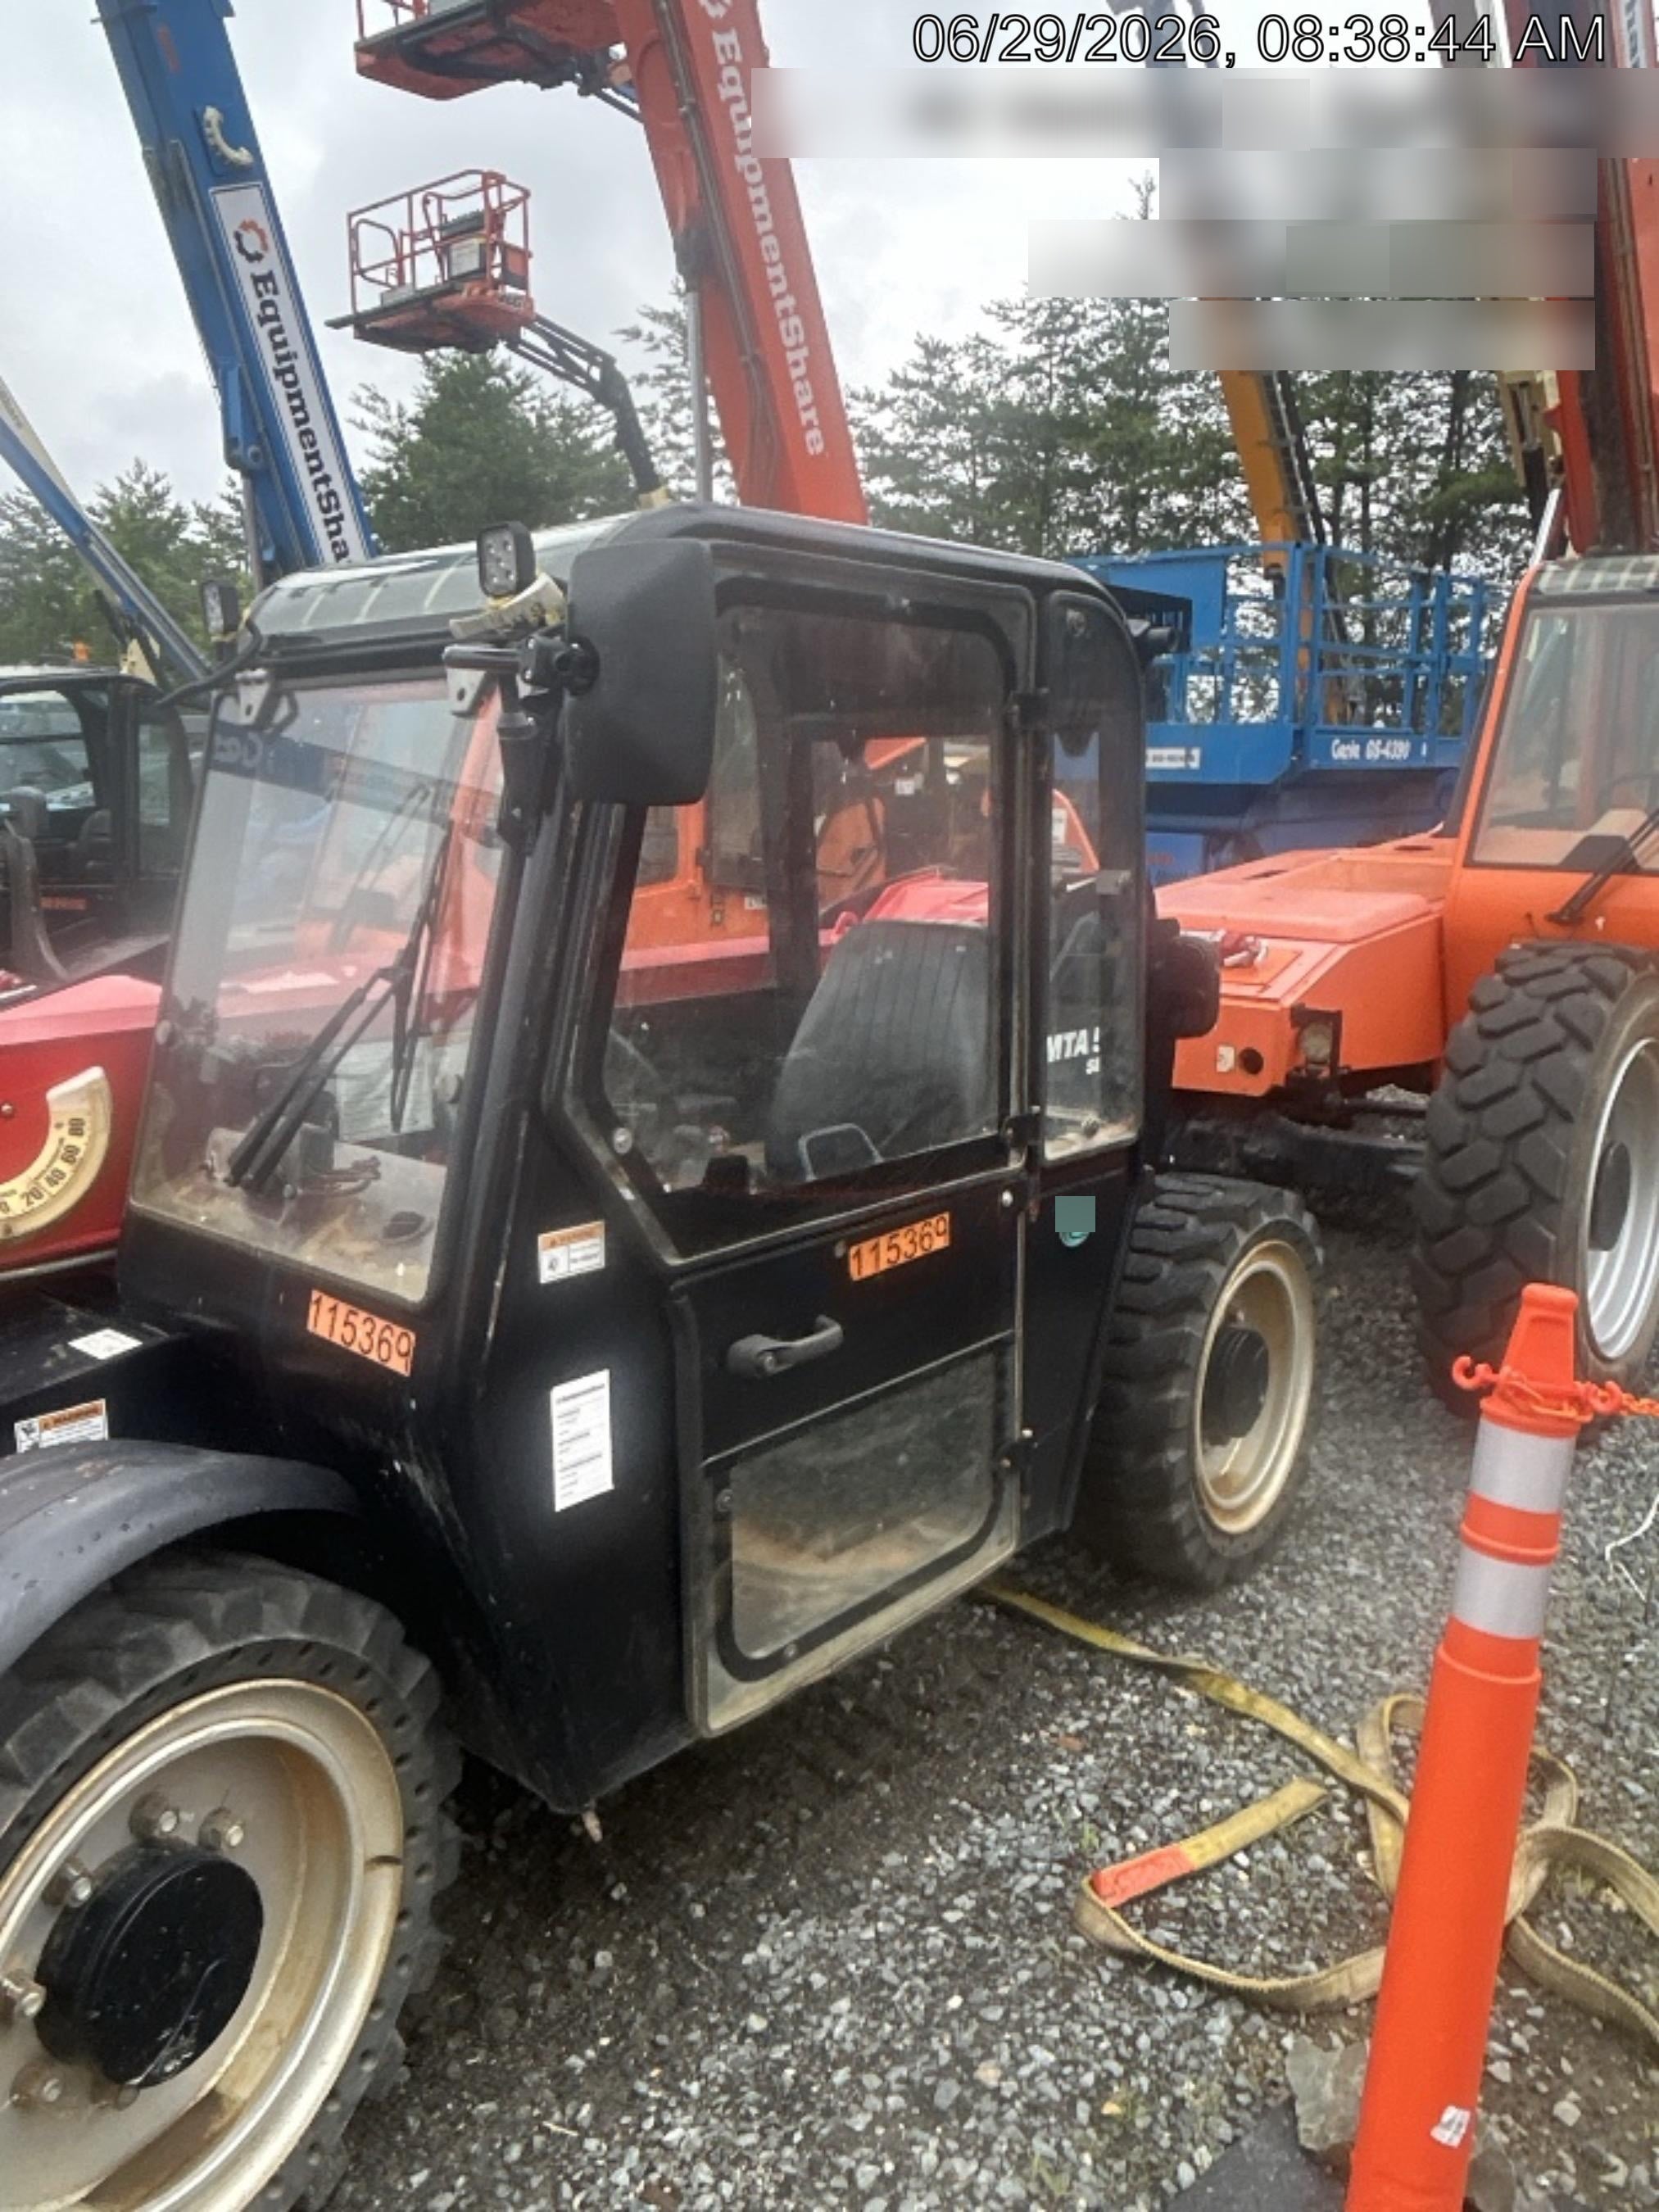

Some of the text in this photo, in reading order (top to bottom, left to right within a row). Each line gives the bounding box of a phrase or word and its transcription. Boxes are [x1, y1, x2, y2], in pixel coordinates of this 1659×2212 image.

[249, 270, 351, 564] EquipmentSha
[20, 1185, 45, 1207] 20
[45, 1167, 66, 1187] 40
[312, 1294, 411, 1373] 115369
